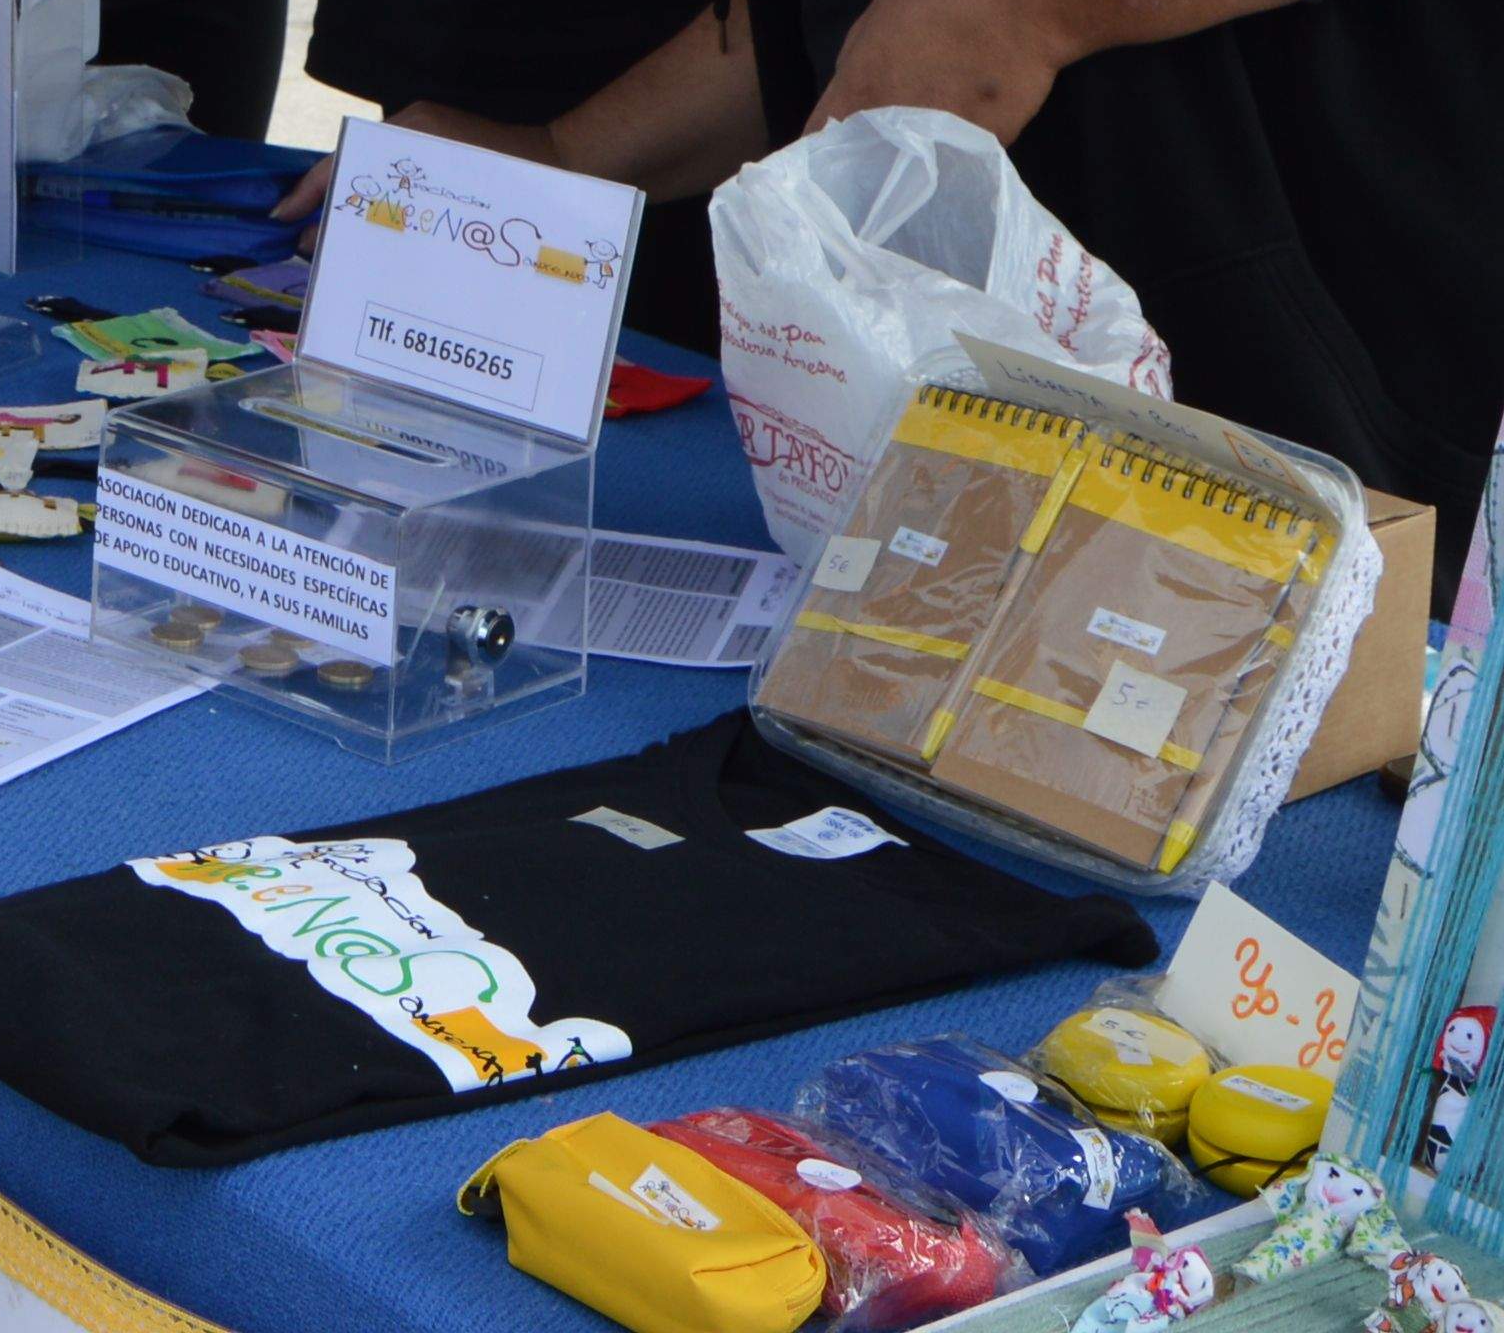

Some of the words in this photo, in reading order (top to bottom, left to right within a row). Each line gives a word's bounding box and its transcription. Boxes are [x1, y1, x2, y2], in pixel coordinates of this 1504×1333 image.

[368, 314, 397, 346] Tlf.
[402, 327, 515, 382] 681656265
[93, 529, 110, 547] DE
[112, 533, 160, 566] APOYO
[163, 554, 245, 599] EDUCATIVO,
[248, 582, 257, 601] Y
[259, 589, 271, 606] A
[273, 593, 301, 616] SUS
[303, 601, 369, 641] FAMILIAS
[95, 503, 163, 539] PERSONAS
[169, 528, 198, 552] CON
[204, 540, 297, 586] NECESIDADES
[303, 575, 389, 619] ESPECÍFICAS
[96, 475, 177, 516] ASOCIACIÓN
[181, 504, 252, 542] DEDICADA
[255, 532, 266, 547] A
[271, 535, 289, 555] LA
[293, 545, 366, 581] ATENCIÓN
[370, 569, 390, 590] DE
